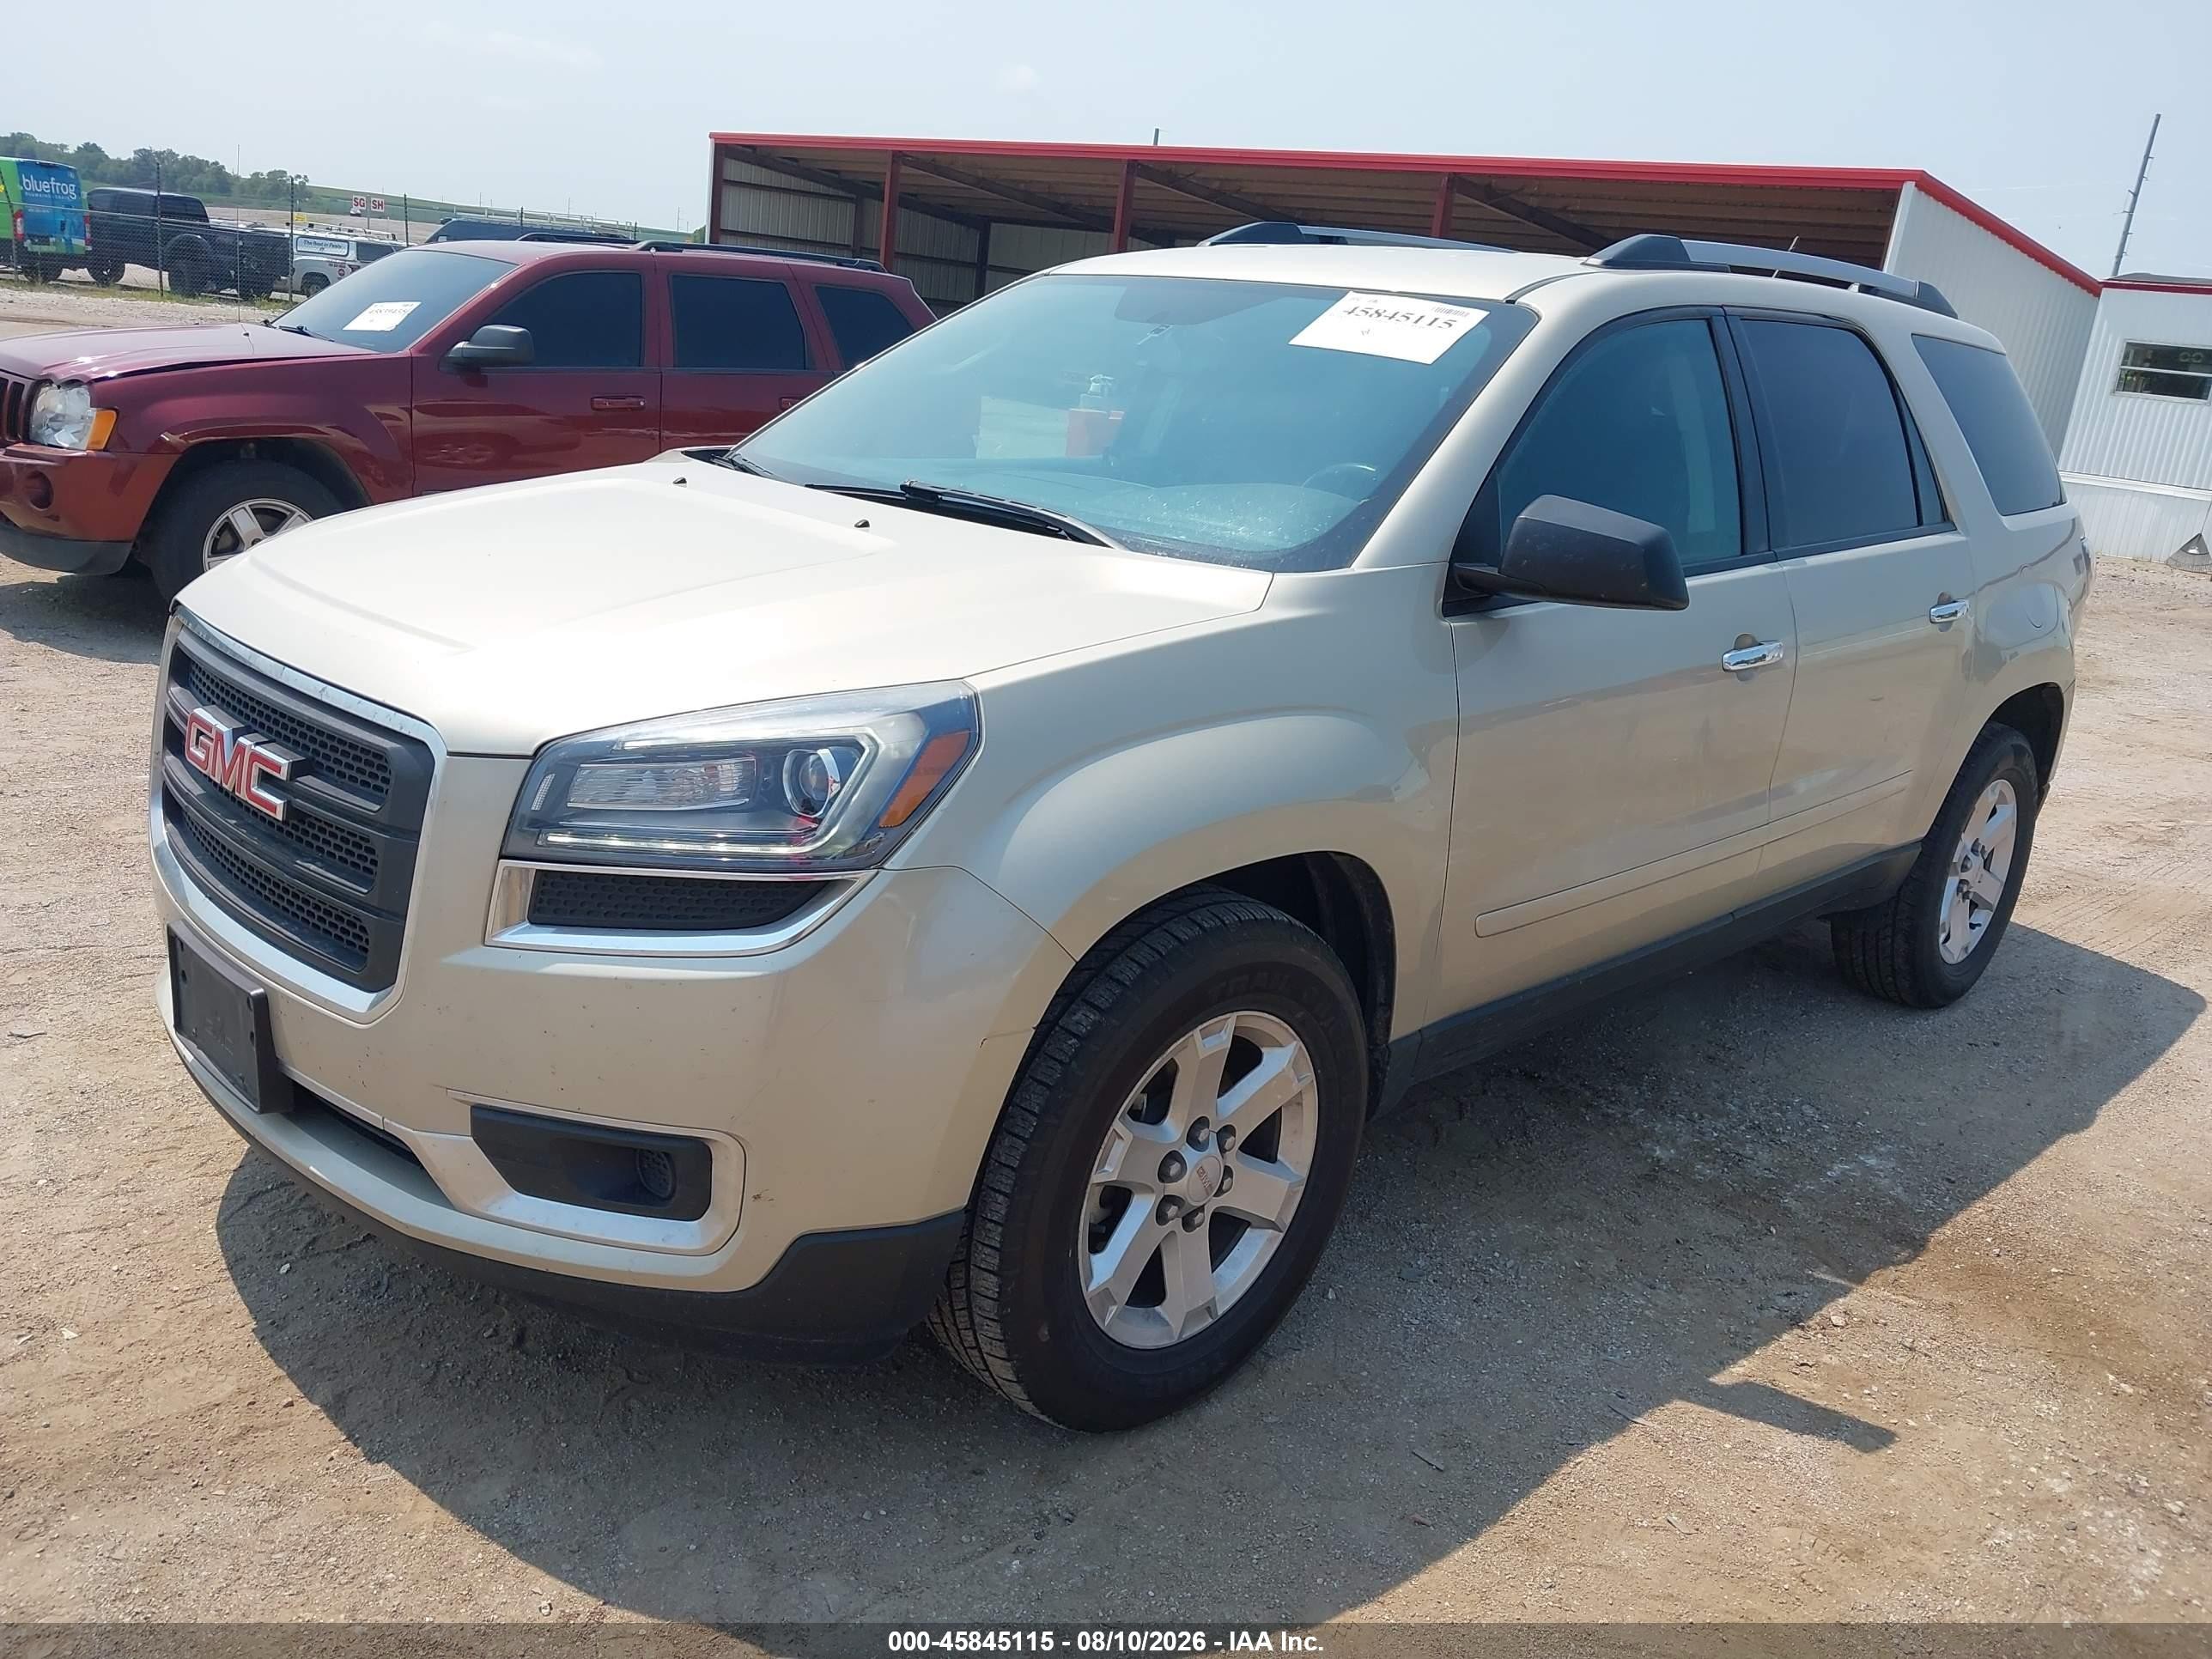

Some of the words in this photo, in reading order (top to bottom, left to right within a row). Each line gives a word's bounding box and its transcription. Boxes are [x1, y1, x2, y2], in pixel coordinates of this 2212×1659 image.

[21, 173, 77, 199] bluefrog
[353, 198, 365, 208] SG
[372, 199, 384, 210] SH
[1343, 306, 1457, 329] 45845115
[185, 707, 290, 822] GMC
